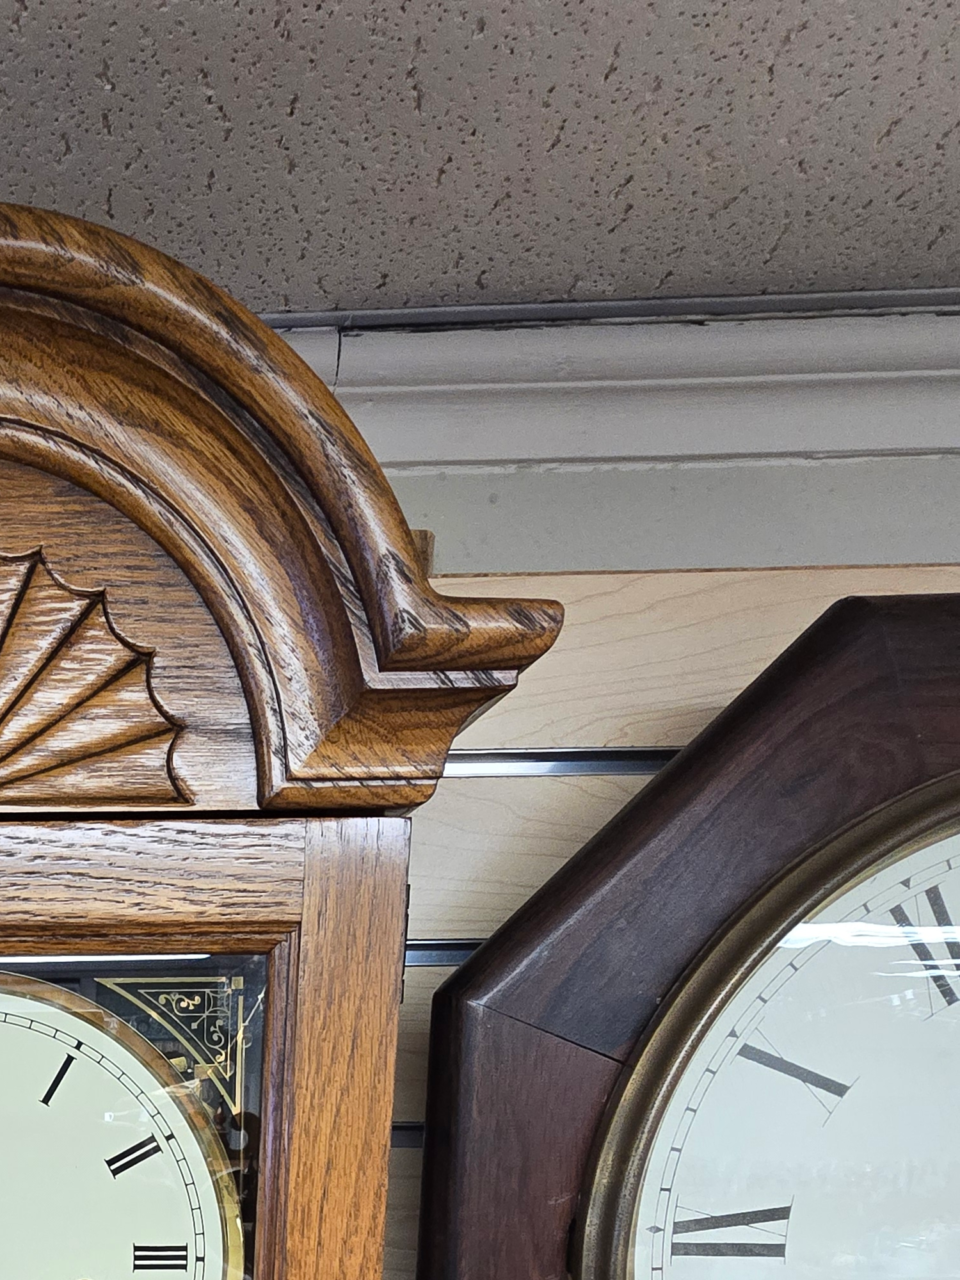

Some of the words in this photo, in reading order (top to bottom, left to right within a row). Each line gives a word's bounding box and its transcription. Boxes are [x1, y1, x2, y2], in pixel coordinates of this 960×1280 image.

[38, 1053, 77, 1107] I
[104, 1132, 163, 1179] II
[132, 1242, 189, 1273] III
